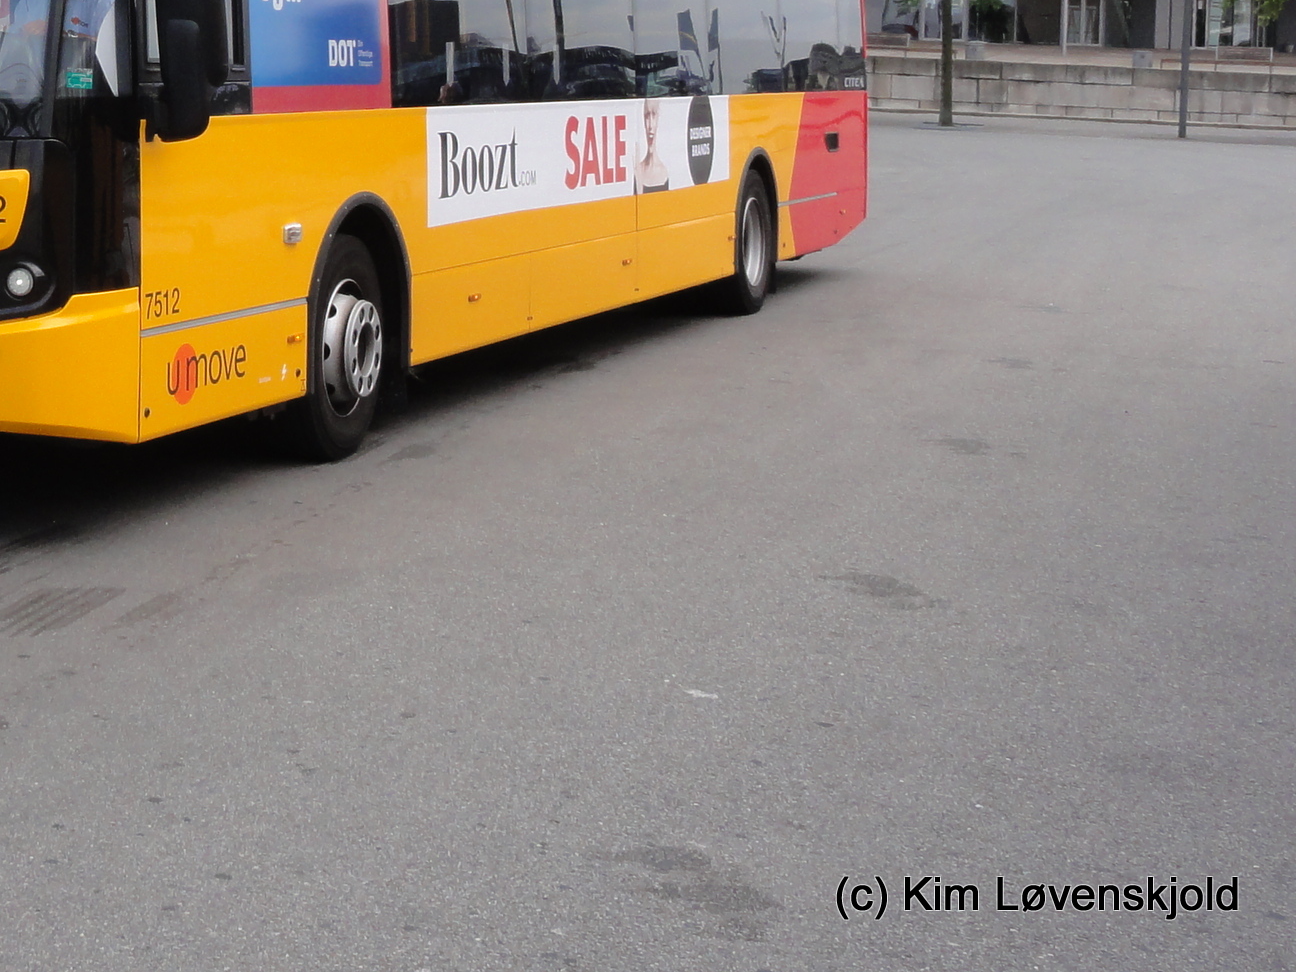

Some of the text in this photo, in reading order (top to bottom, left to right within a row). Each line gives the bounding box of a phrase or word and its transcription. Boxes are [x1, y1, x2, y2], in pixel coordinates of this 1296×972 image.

[689, 125, 712, 140] DESIGNER
[564, 114, 627, 190] SALE
[691, 142, 710, 157] BRANDS
[145, 287, 181, 319] 7512
